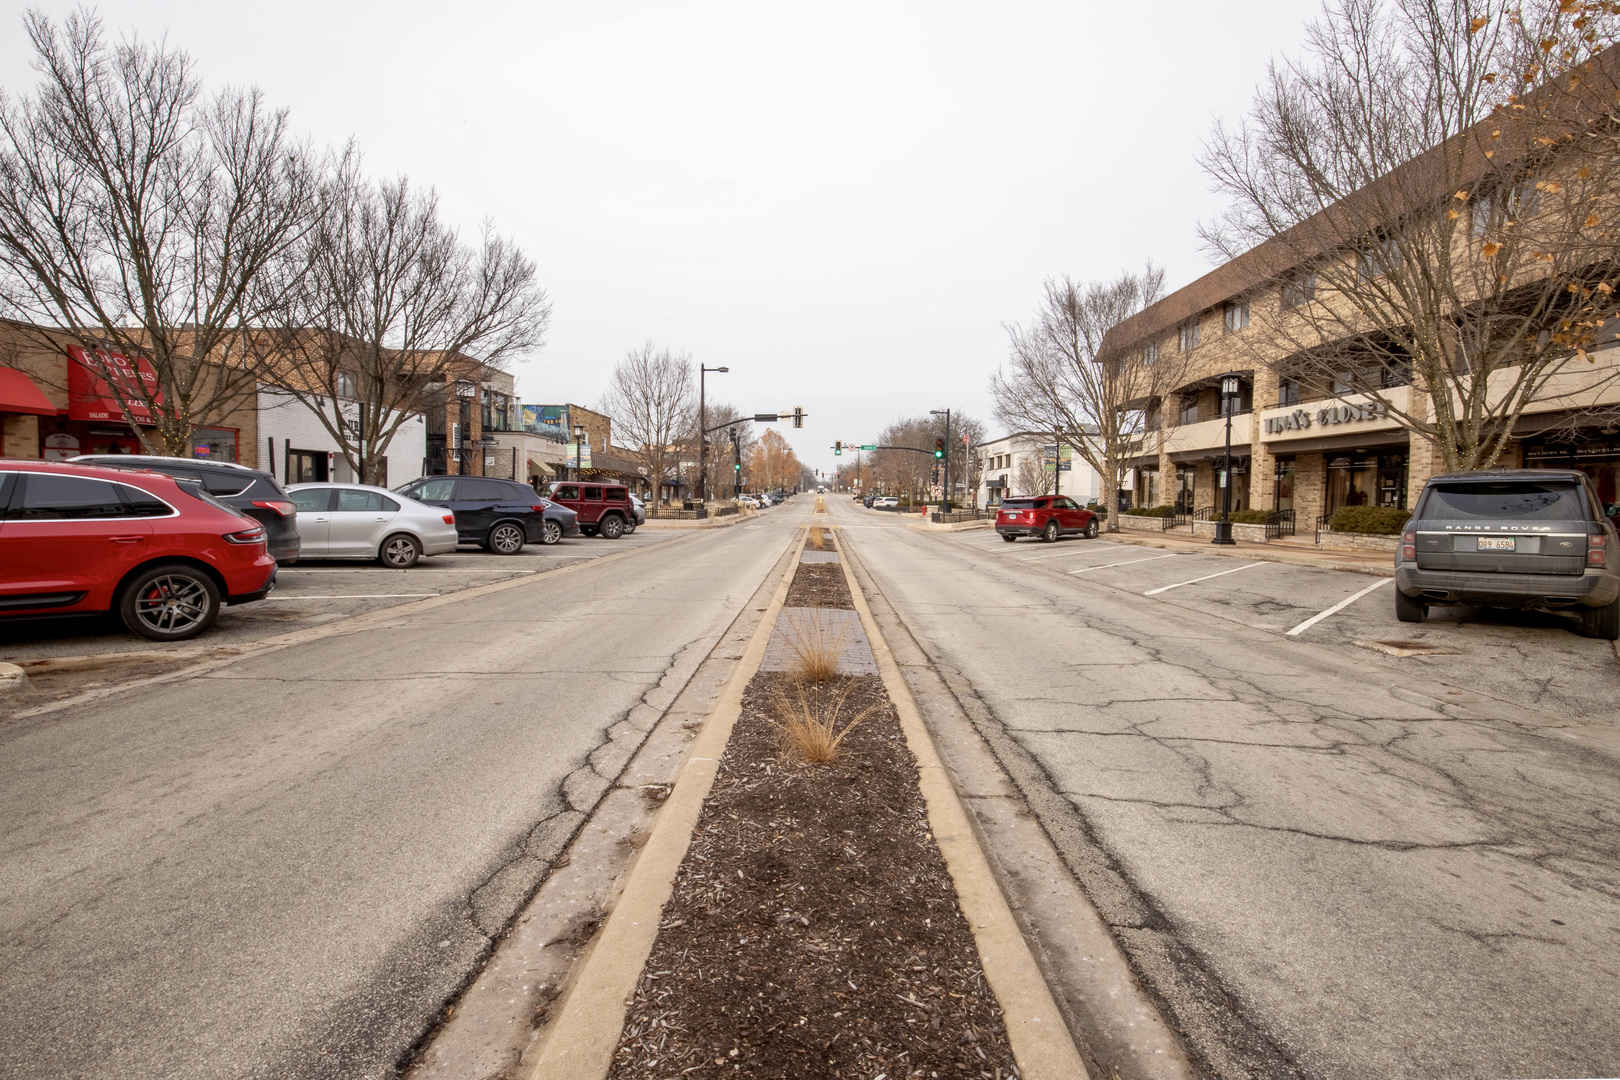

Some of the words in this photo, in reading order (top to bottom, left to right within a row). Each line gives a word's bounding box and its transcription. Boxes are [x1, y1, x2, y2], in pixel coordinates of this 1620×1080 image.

[104, 364, 155, 381] EES
[121, 414, 145, 423] GOS
[1264, 409, 1312, 434] TINA'S
[1316, 400, 1392, 426] CLOSET
[195, 446, 210, 454] OPEN
[1496, 540, 1514, 549] 6584
